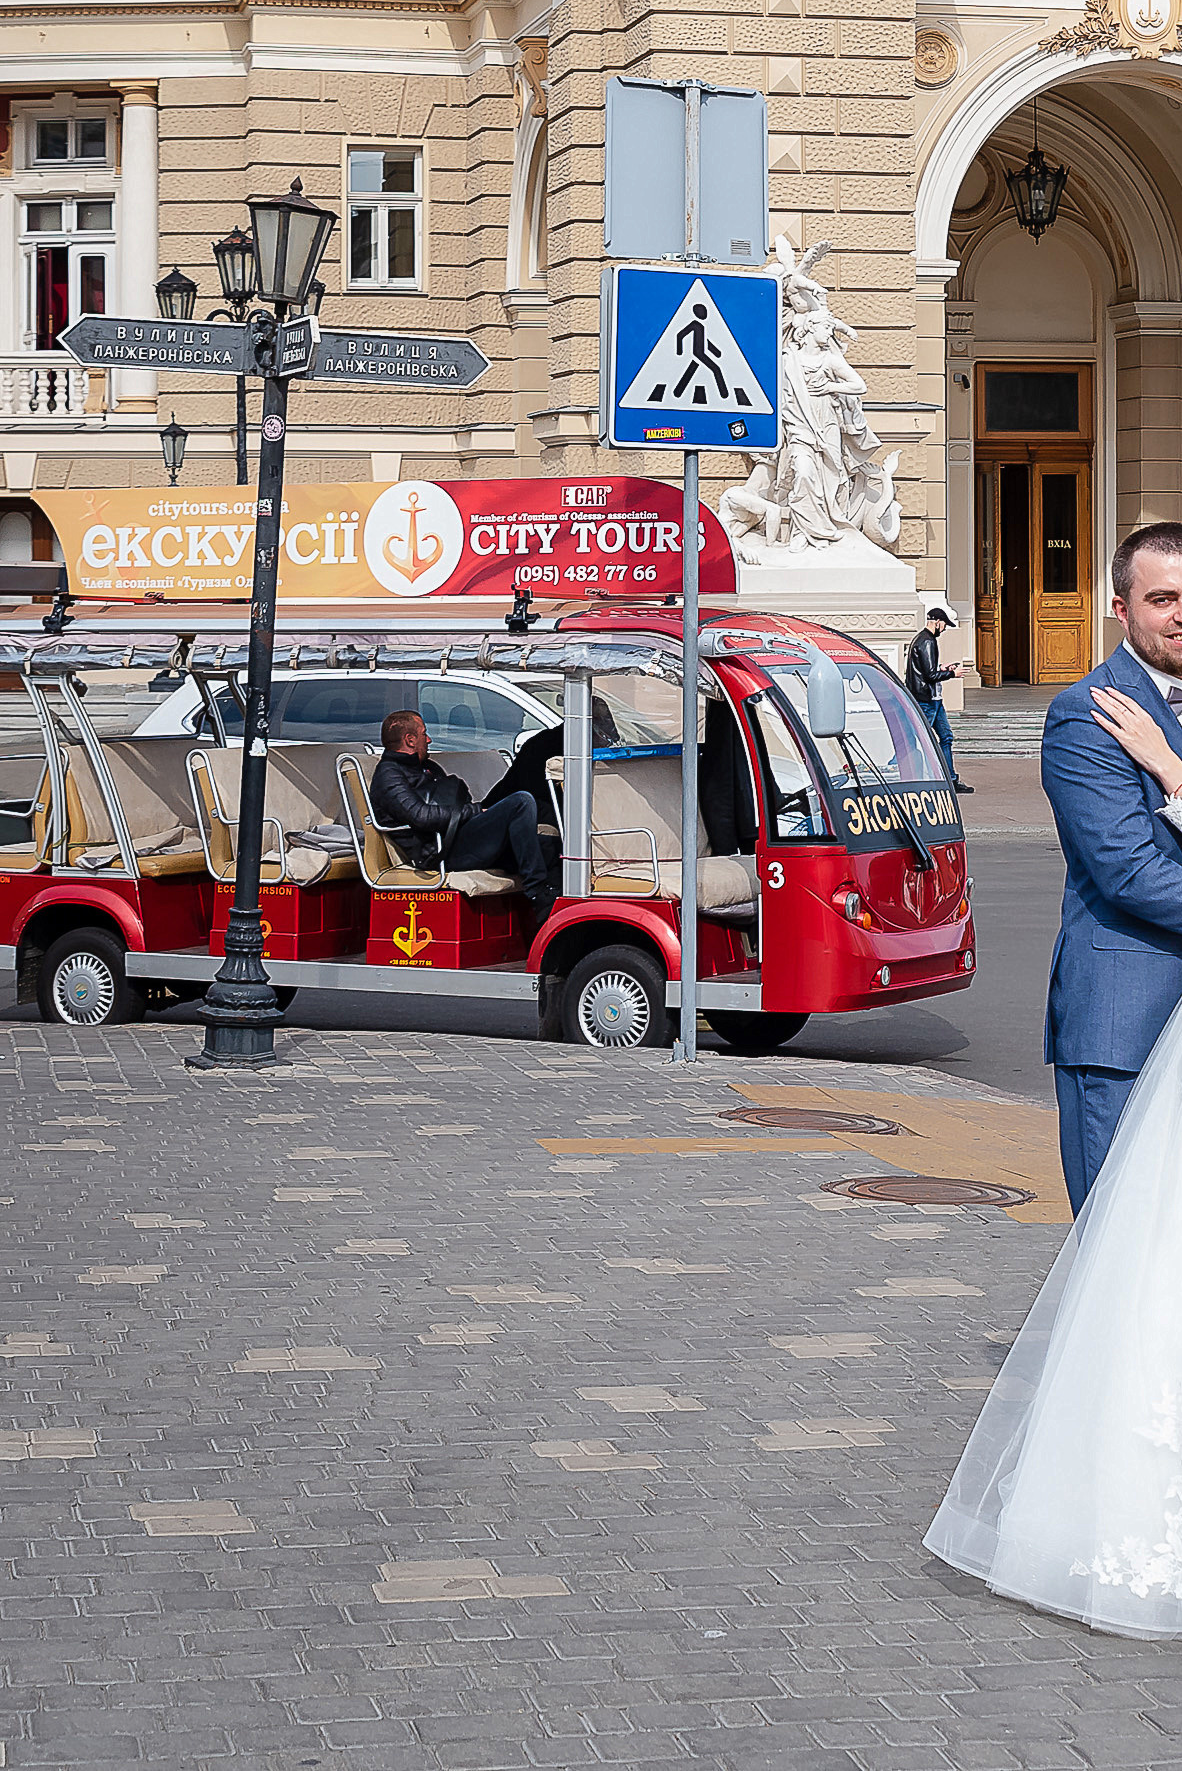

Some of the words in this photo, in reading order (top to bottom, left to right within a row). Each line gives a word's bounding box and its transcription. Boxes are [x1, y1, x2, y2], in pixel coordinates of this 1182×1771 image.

[117, 326, 211, 345] ВУЛИЦЯ
[347, 341, 438, 360] ВУЛИЦЯ
[470, 514, 505, 523] Member
[507, 513, 517, 522] of
[559, 512, 569, 521] of
[607, 510, 659, 520] association
[82, 511, 360, 568] екскусії
[469, 522, 561, 555] CITY
[81, 577, 113, 589] Член
[115, 577, 175, 589] асоціації
[514, 565, 559, 586] (095)
[563, 565, 599, 582] 482
[604, 565, 628, 581] 77
[633, 564, 657, 581] 66
[767, 861, 785, 889] 3
[373, 891, 453, 902] ECOEXCURSION
